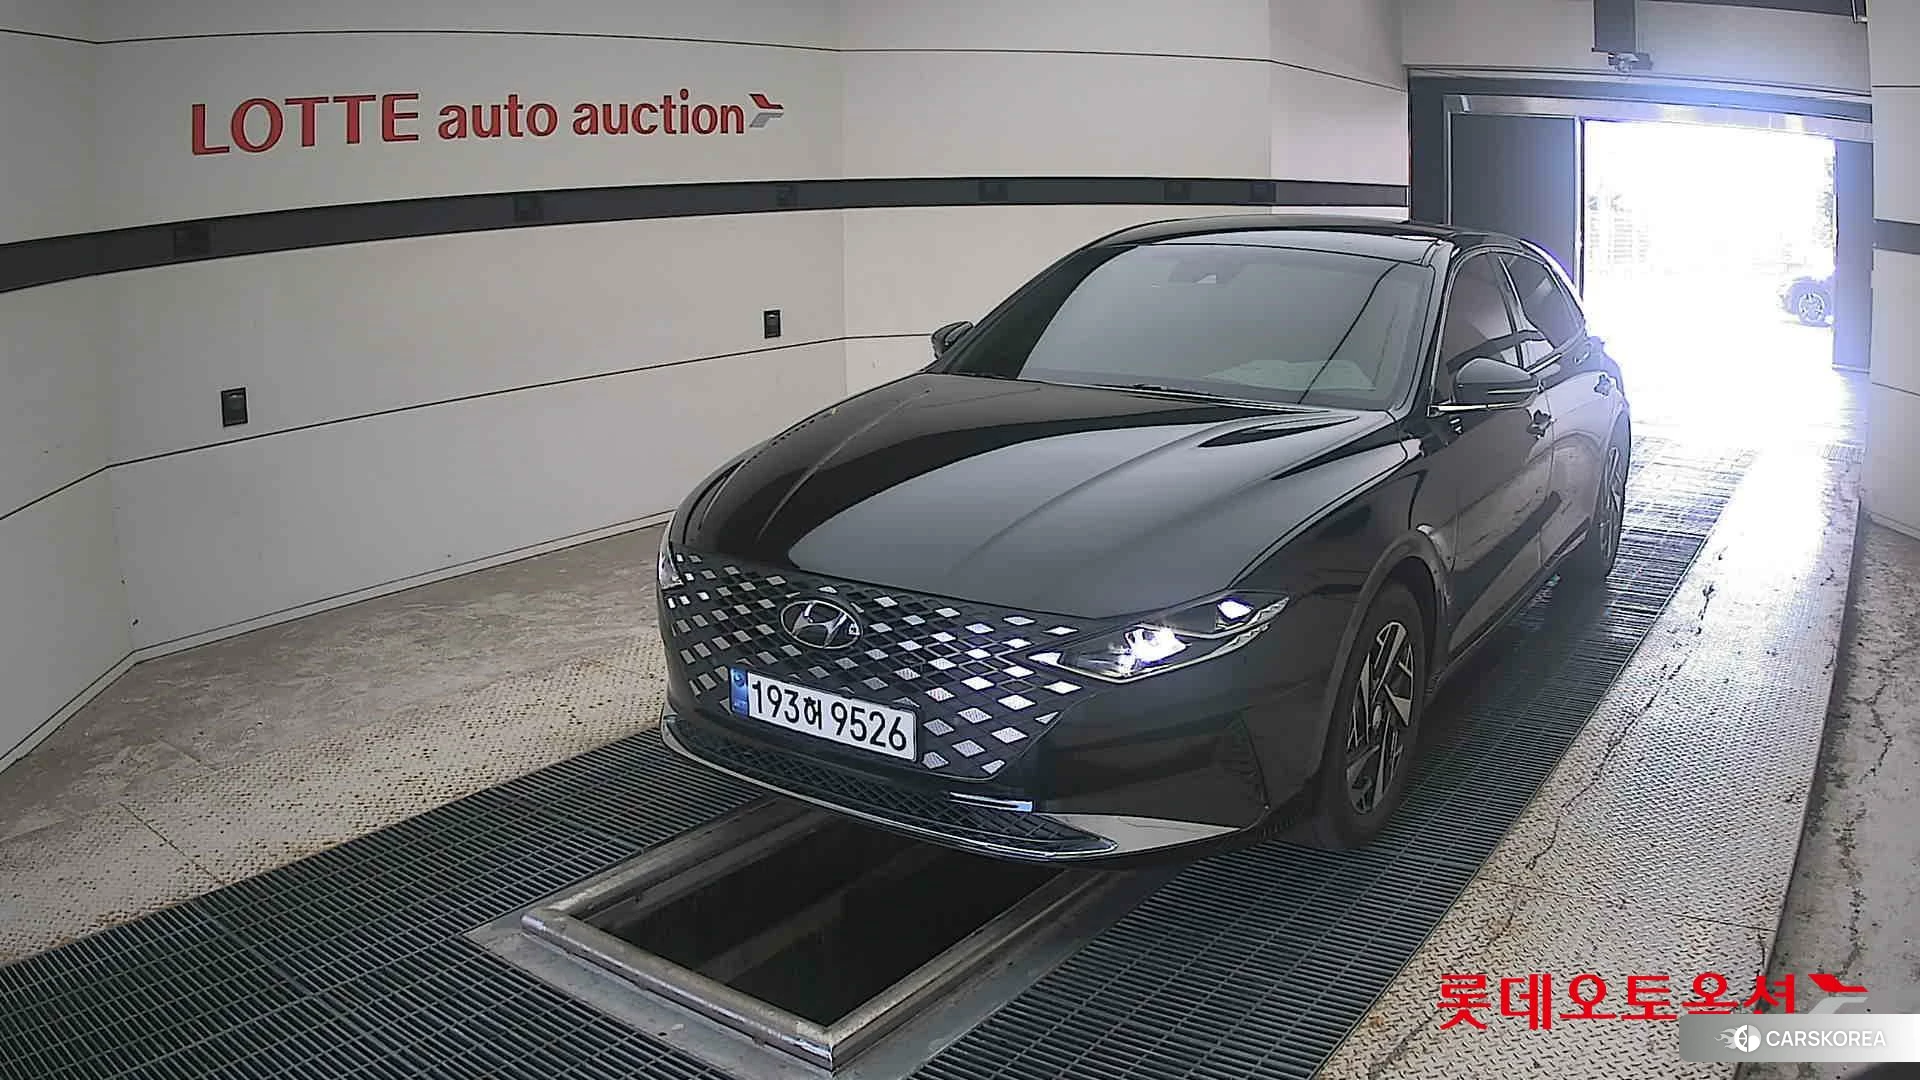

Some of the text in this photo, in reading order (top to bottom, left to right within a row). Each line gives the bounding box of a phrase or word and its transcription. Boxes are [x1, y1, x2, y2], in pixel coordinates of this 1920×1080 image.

[192, 89, 744, 155] LOTTE auto auction
[831, 701, 907, 751] 9526
